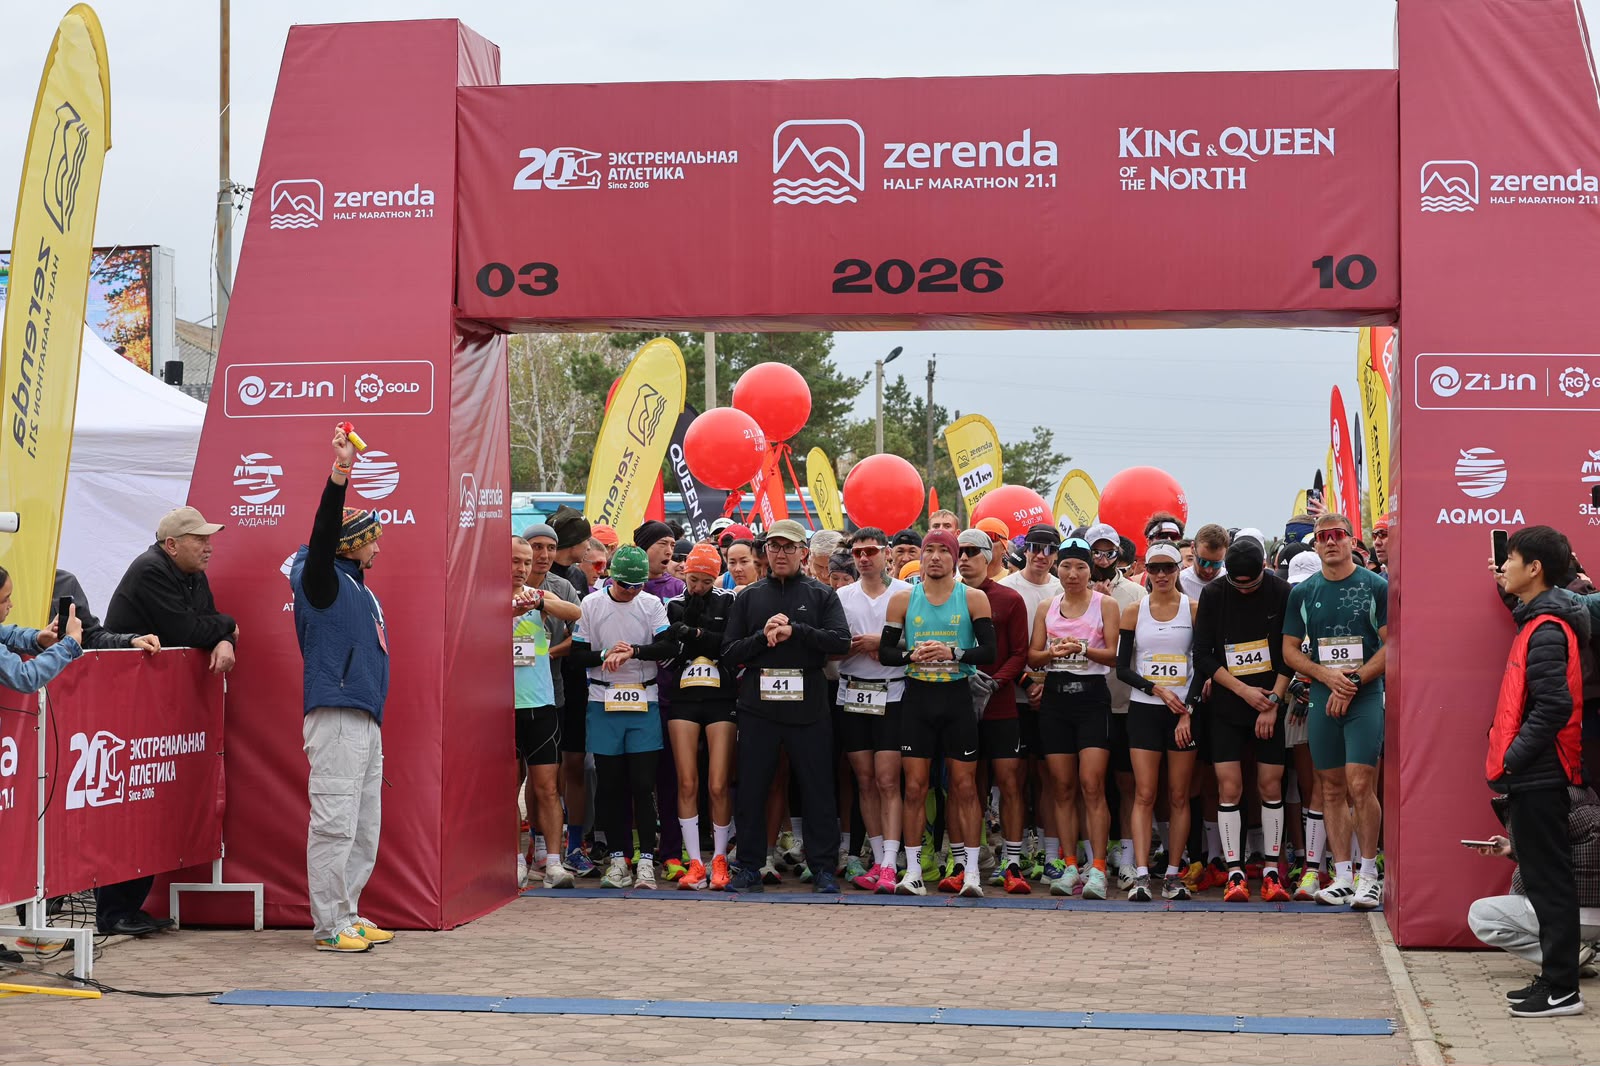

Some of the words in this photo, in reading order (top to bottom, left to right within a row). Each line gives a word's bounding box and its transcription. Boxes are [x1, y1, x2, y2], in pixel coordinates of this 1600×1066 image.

[883, 127, 1058, 169] zerenda
[1118, 127, 1200, 159] KING
[1206, 144, 1218, 157] &
[1219, 126, 1335, 162] QUEEN
[608, 150, 738, 165] ЭКСТРЕМАЛЬНАЯ
[607, 166, 684, 180] АТЛЕТИКА
[1119, 166, 1138, 178] OF
[1150, 165, 1246, 191] NORTH
[607, 181, 628, 190] Since
[629, 181, 649, 190] 2006
[883, 178, 923, 190] HALF
[928, 177, 1018, 190] MARATHON
[1024, 173, 1057, 188] 21.1
[1119, 179, 1145, 190] THE
[1490, 168, 1599, 192] zerenda
[333, 183, 435, 207] zerenda
[1490, 196, 1516, 204] HALF
[1518, 196, 1575, 204] MARATHON
[1578, 195, 1599, 205] 21.1
[333, 212, 357, 220] HALF
[359, 211, 411, 219] MARATHON
[414, 209, 434, 218] 21.1
[832, 257, 1004, 294] 2026
[1312, 254, 1377, 290] 10
[475, 262, 559, 297] 03
[360, 383, 378, 393] RG
[385, 383, 420, 393] GOLD
[1565, 377, 1584, 388] RG
[669, 443, 703, 519] QUEEN
[230, 505, 285, 517] ЗЕРЕНДІ
[374, 509, 416, 524] OLA
[1013, 508, 1028, 521] 30
[1436, 508, 1526, 525] AQMOLA
[238, 517, 278, 528] АУДАНЫ
[1235, 652, 1263, 666] 344
[1331, 648, 1349, 659] 98
[688, 667, 711, 677] 411
[1151, 664, 1178, 676] 216
[772, 680, 789, 690] 41
[613, 691, 640, 702] 409
[857, 692, 872, 703] 81
[129, 731, 206, 761] ЭКСТРЕМАЛЬНАЯ
[129, 760, 176, 787] АТЛЕТИКА
[128, 788, 141, 801] Since
[141, 787, 155, 800] 2006
